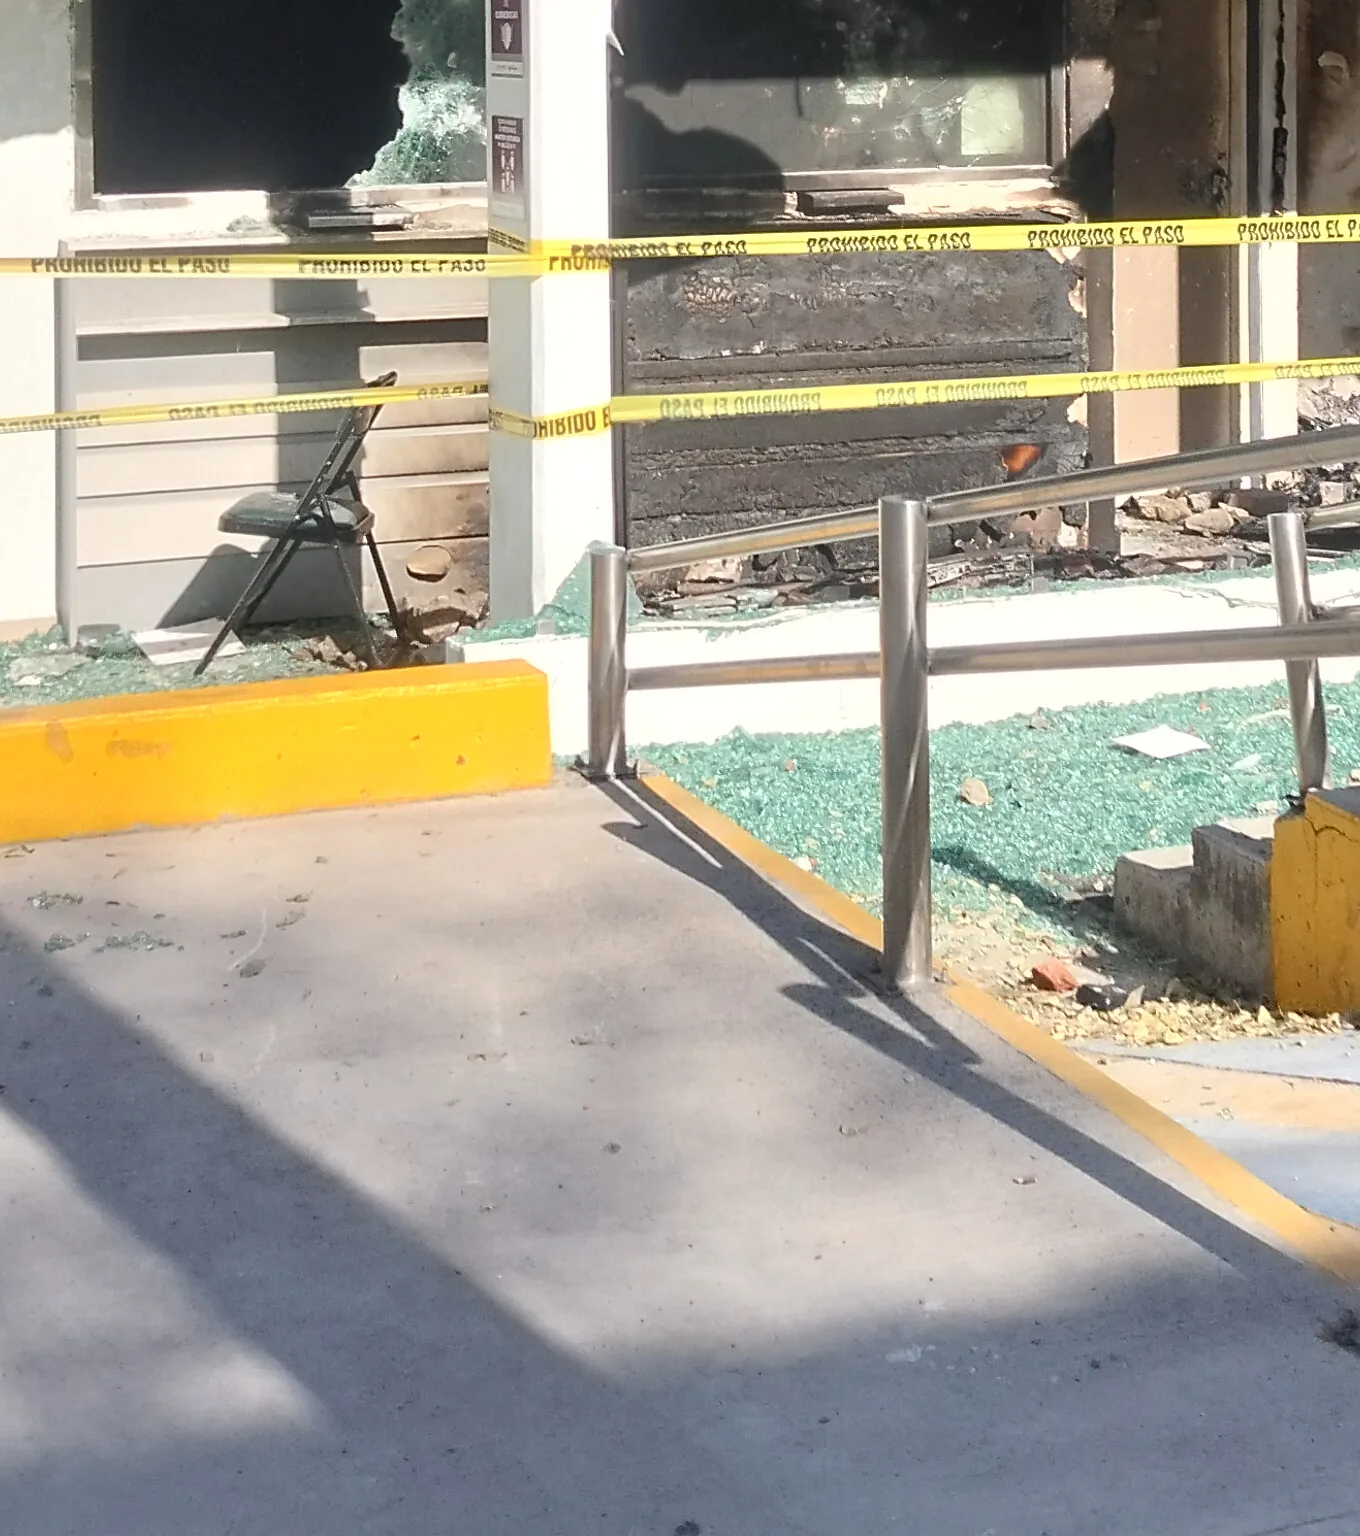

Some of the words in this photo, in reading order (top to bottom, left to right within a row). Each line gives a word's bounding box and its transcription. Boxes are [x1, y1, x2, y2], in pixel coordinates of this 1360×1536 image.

[1027, 228, 1114, 248] PROHIBIDO
[1119, 226, 1138, 244] EL
[1143, 225, 1184, 243] PASO
[1238, 221, 1321, 241] PROHIBIDO
[1326, 219, 1343, 237] EL
[676, 241, 695, 255] EL
[701, 240, 747, 255] PASO
[807, 235, 898, 252] PROHIBIDO
[904, 234, 924, 250] EL
[929, 232, 971, 249] PASO
[31, 257, 140, 274] PROHIBIDO
[150, 257, 172, 273] EL
[178, 257, 230, 273] PASO
